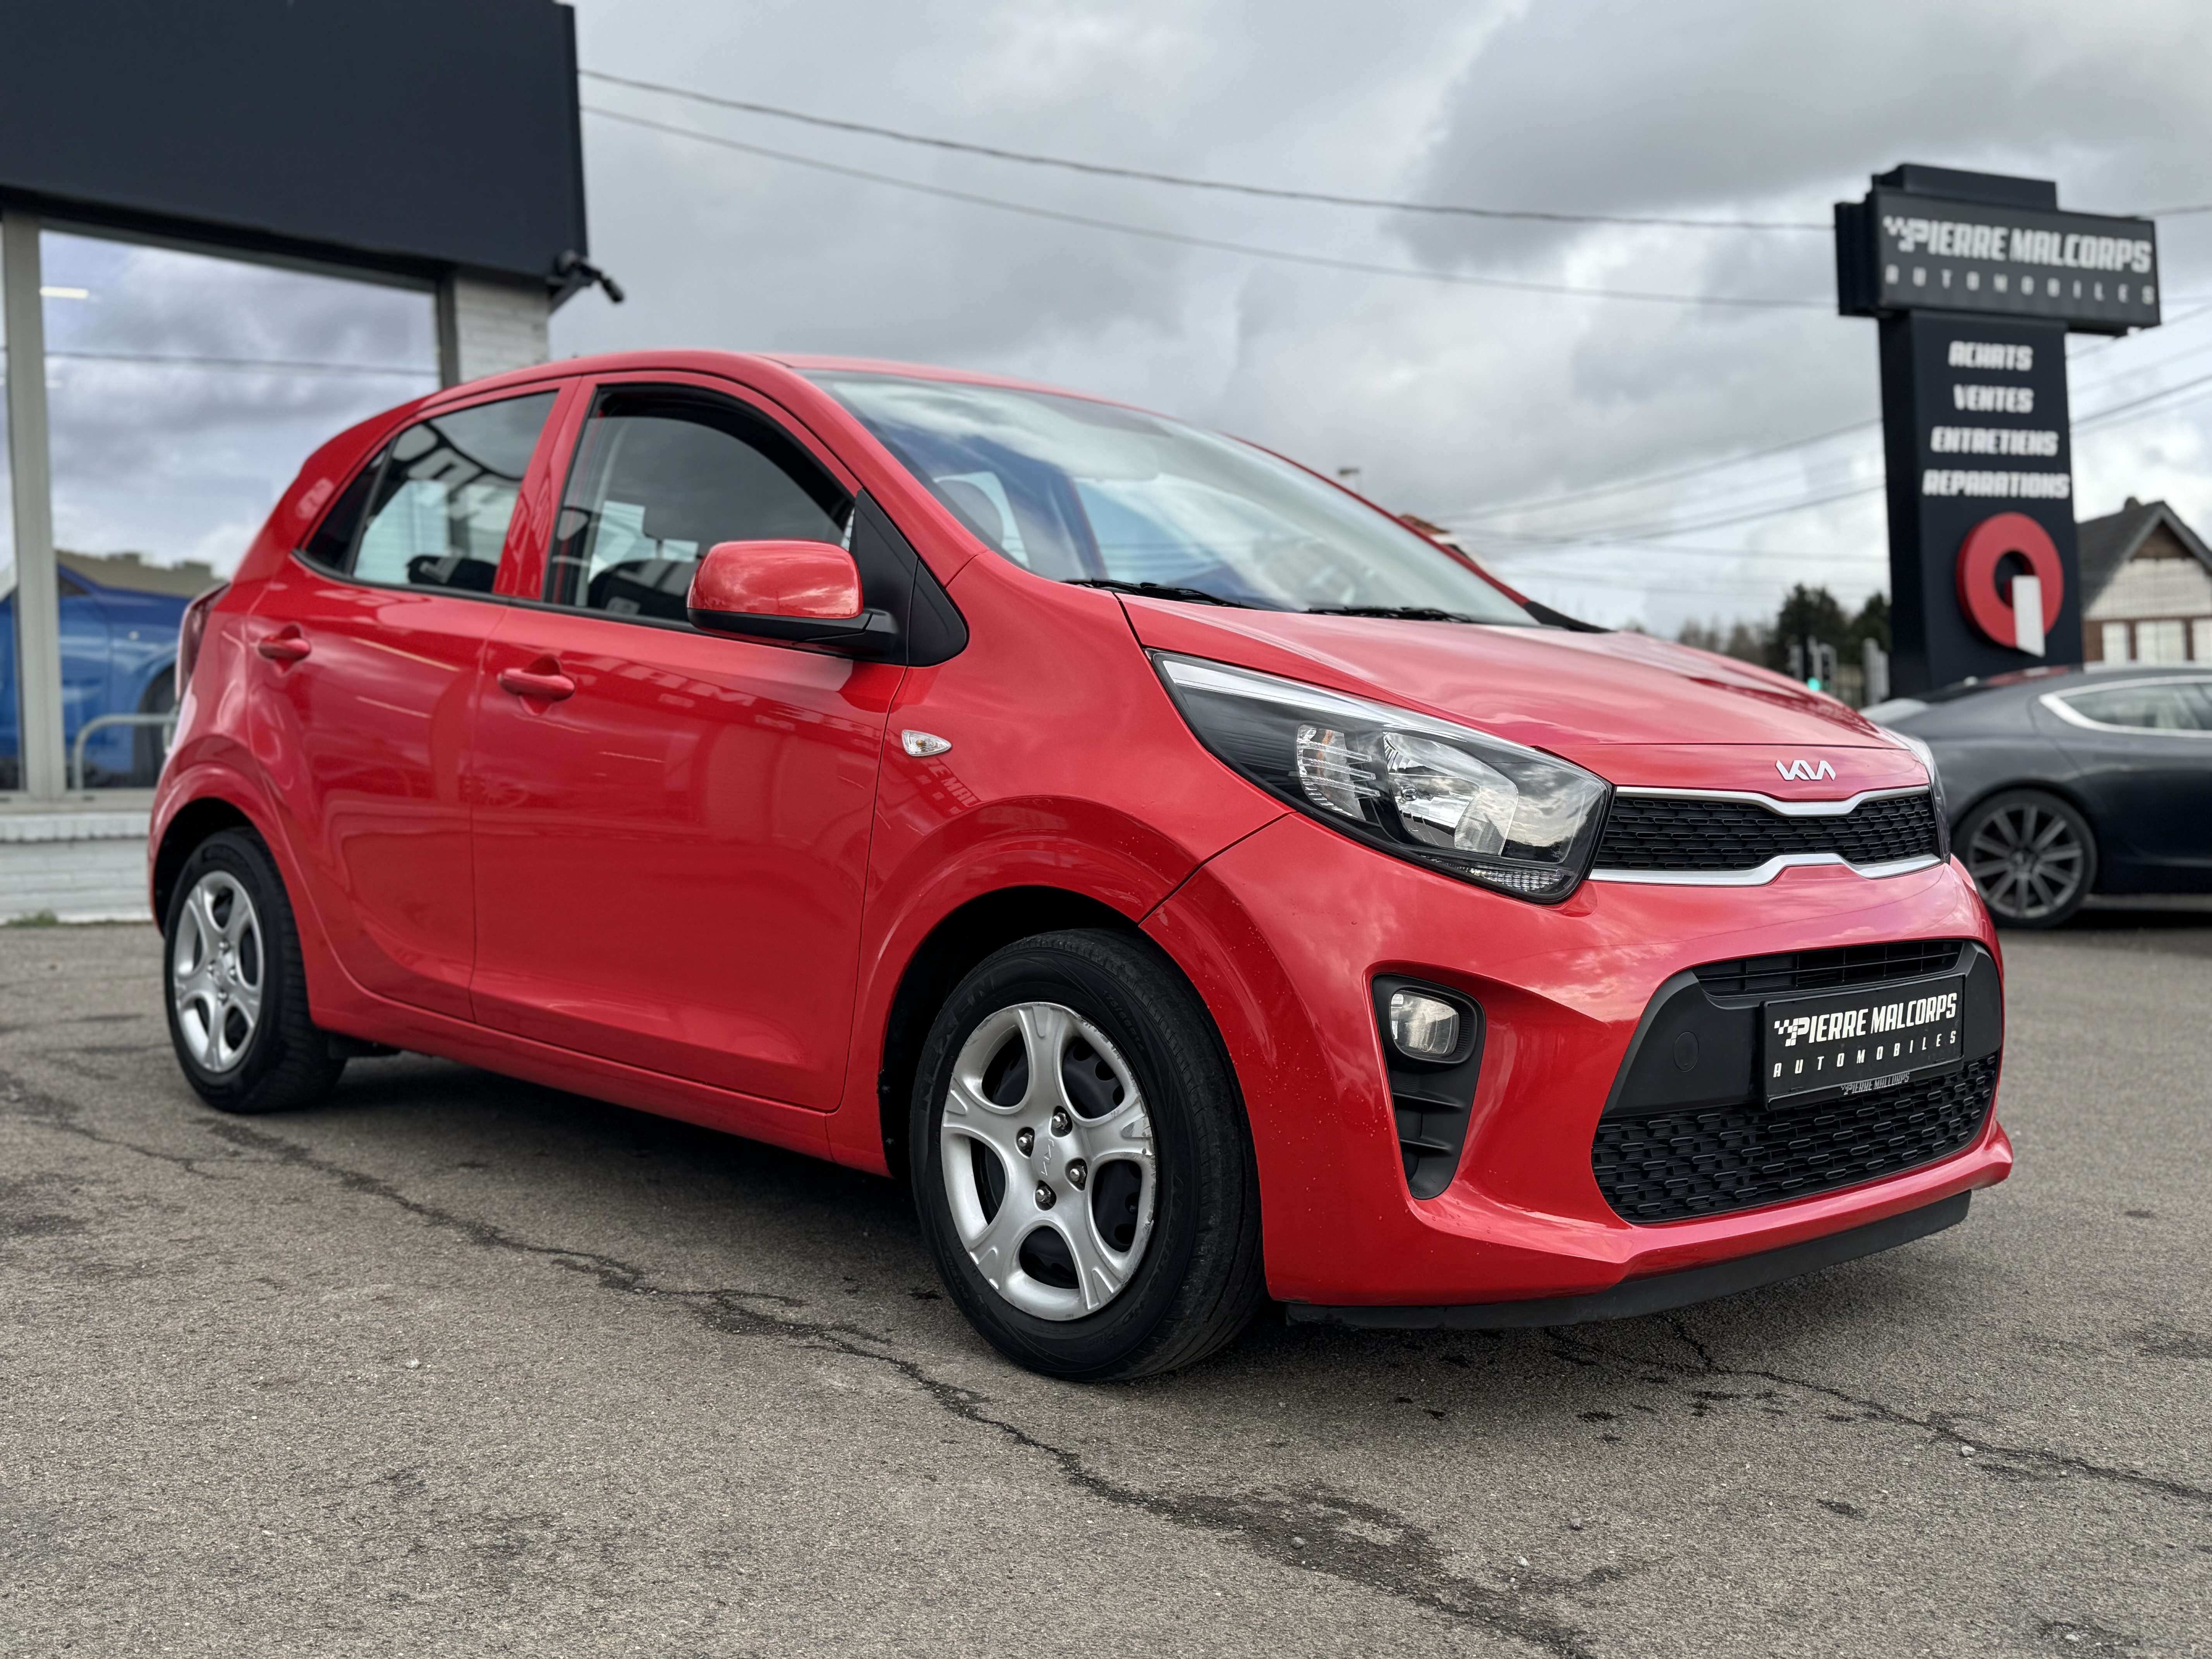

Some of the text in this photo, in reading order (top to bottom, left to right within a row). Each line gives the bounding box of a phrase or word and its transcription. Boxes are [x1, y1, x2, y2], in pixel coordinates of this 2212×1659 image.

[1883, 216, 2152, 273] PIERRE MALCORPS
[1885, 264, 2155, 305] AUTOMOBILES
[1948, 341, 2033, 372] ACHATS
[1953, 384, 2034, 414] VENTES
[1930, 426, 2059, 457] ENTRETIENS
[1922, 470, 2070, 499] REPARATIONS
[1776, 759, 1836, 781] KIA
[1774, 993, 1957, 1047] PIERRE MALCORPS
[1773, 1030, 1956, 1077] AUTOMOBILES
[1841, 1072, 1910, 1095] PIERRE MALCORPS
